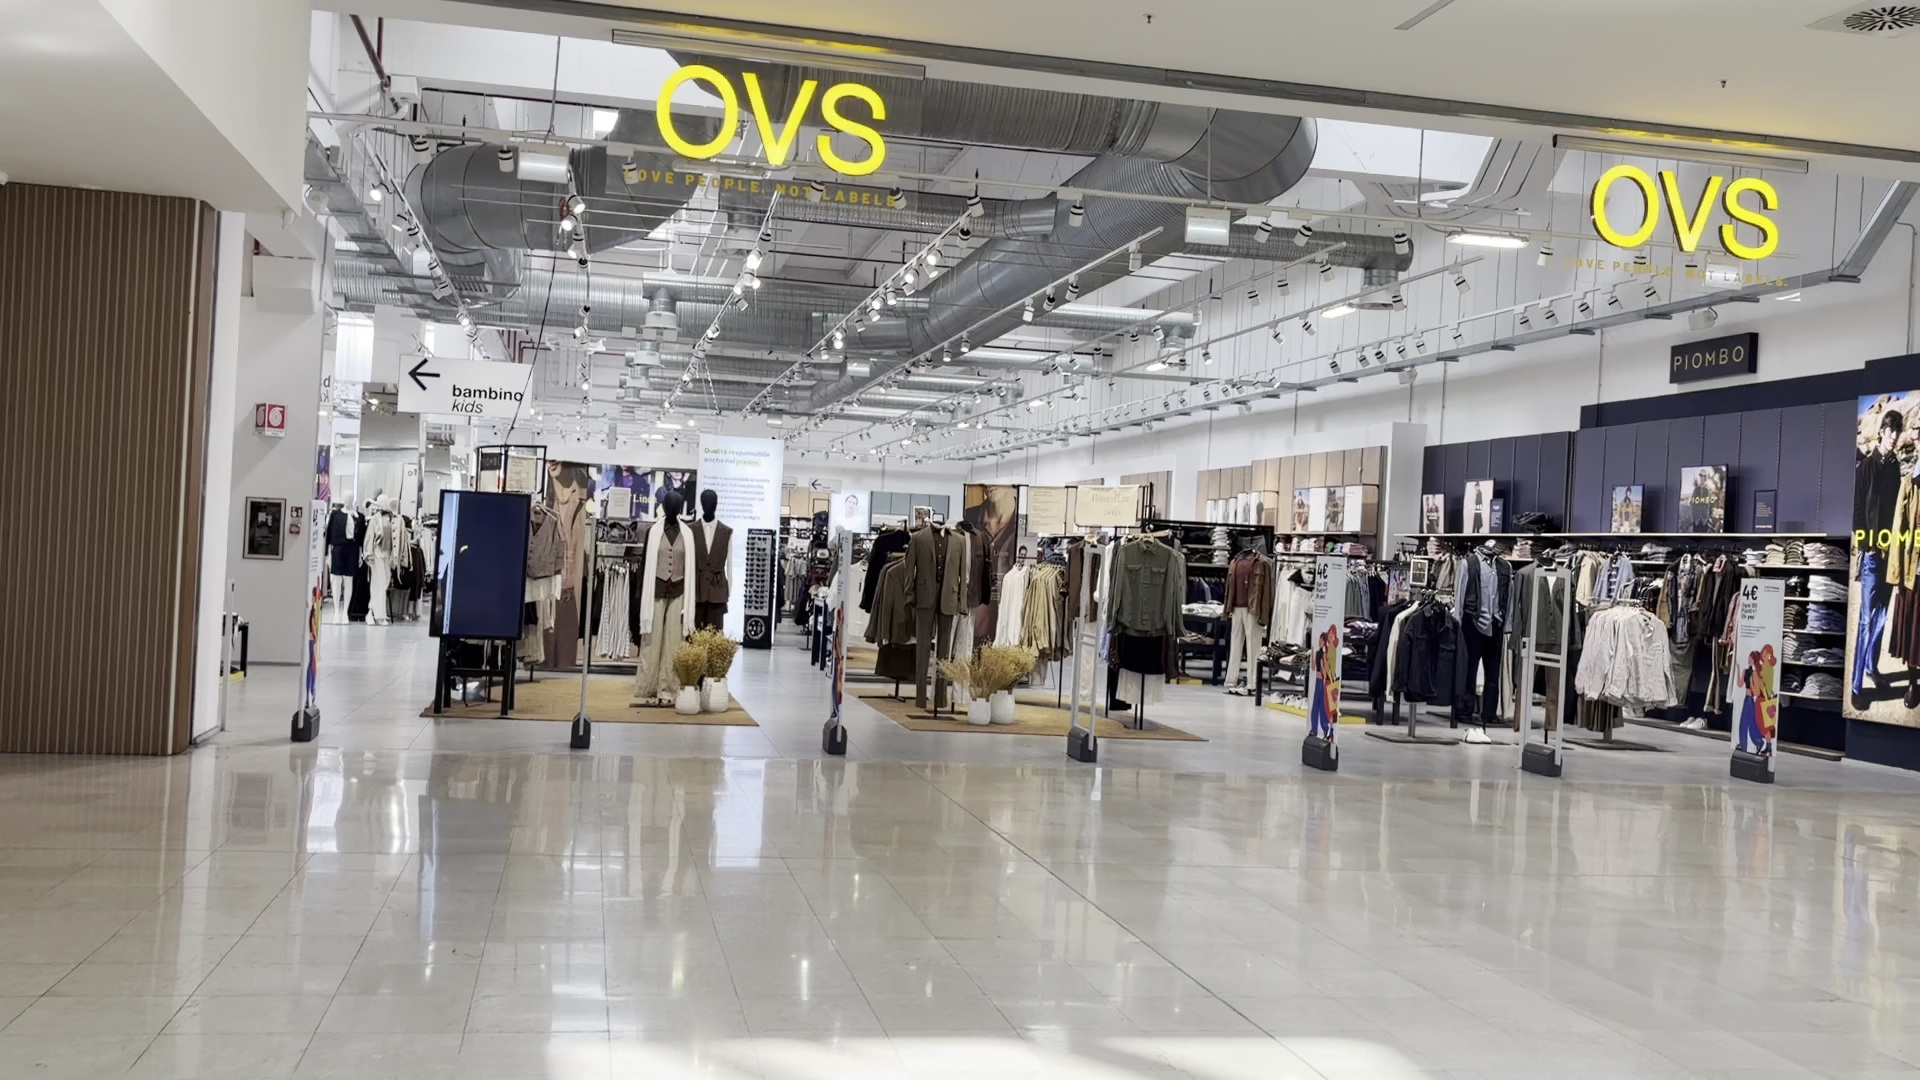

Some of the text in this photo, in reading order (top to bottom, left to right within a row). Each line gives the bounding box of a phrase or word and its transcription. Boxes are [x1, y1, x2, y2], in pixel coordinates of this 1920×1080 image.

[656, 64, 886, 176] OVS
[623, 168, 674, 185] LOVE
[775, 183, 812, 198] NOT
[1590, 164, 1779, 260] OVS
[1673, 345, 1744, 371] PIOMBO
[452, 384, 524, 402] bambino
[451, 399, 484, 414] kids
[1317, 563, 1329, 580] 4€
[1742, 584, 1759, 601] 4€
